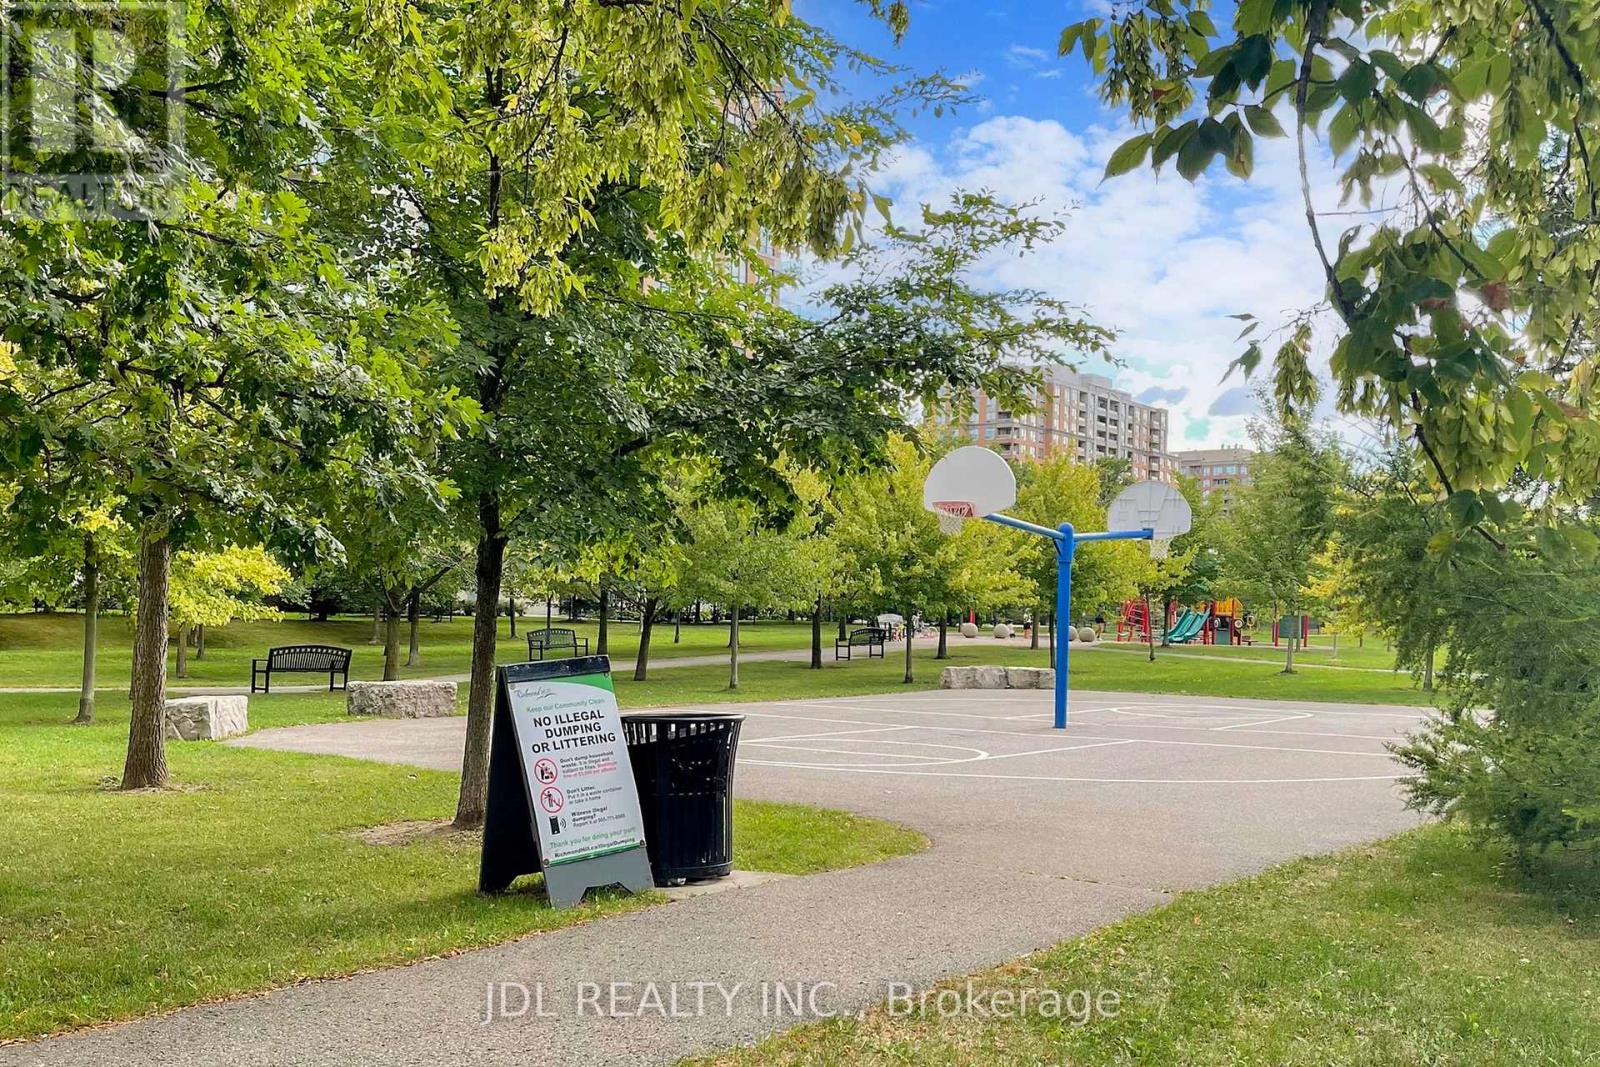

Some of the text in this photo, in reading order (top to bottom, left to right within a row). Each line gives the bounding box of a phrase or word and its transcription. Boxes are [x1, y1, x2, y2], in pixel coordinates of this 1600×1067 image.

[554, 700, 588, 710] Community
[533, 710, 604, 727] NO ILLEGAL
[545, 722, 602, 738] DUMPING
[532, 733, 616, 753] OR LITTERING
[550, 840, 568, 848] Thank
[591, 832, 609, 842] doing
[610, 831, 623, 839] your
